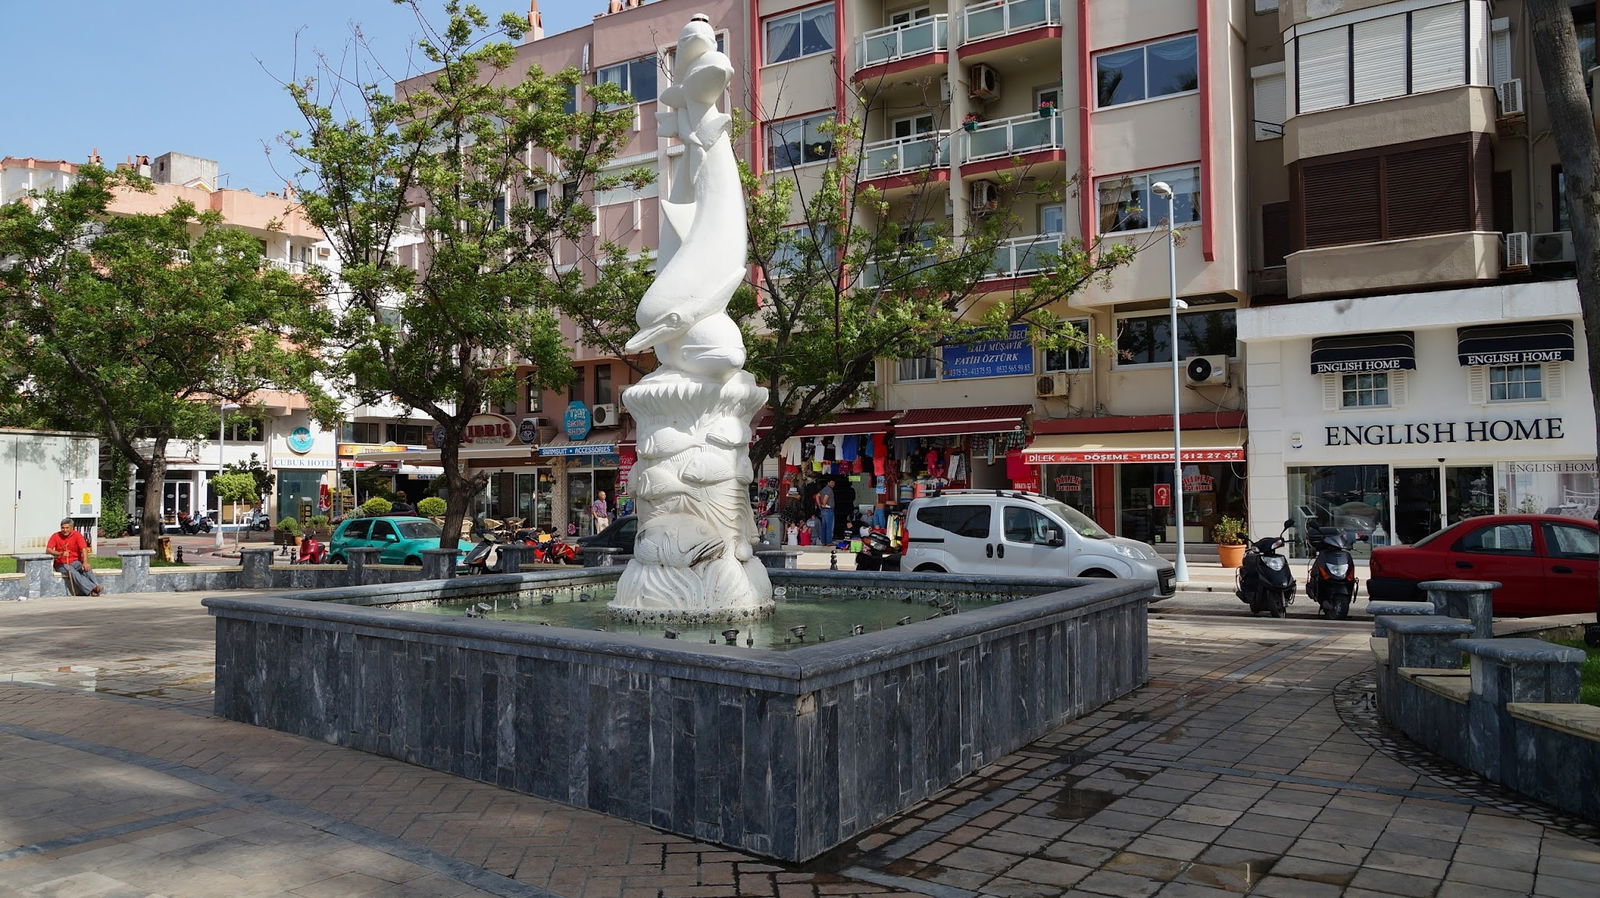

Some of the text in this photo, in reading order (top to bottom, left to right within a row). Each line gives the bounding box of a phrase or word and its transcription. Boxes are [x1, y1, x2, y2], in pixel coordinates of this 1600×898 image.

[954, 352, 1019, 366] FATİH ÖZTÜRK
[1467, 351, 1562, 365] ENGLISH HOME
[1317, 360, 1401, 373] ENGLISH HOME
[1324, 417, 1566, 447] ENGLISH HOME
[574, 445, 611, 454] ACCESSORIES
[307, 458, 335, 467] HOTEL
[1028, 453, 1056, 462] DİLEK
[1083, 453, 1129, 462] DÖŞEME
[1223, 451, 1239, 459] 42
[1509, 463, 1562, 473] ENGLISH
